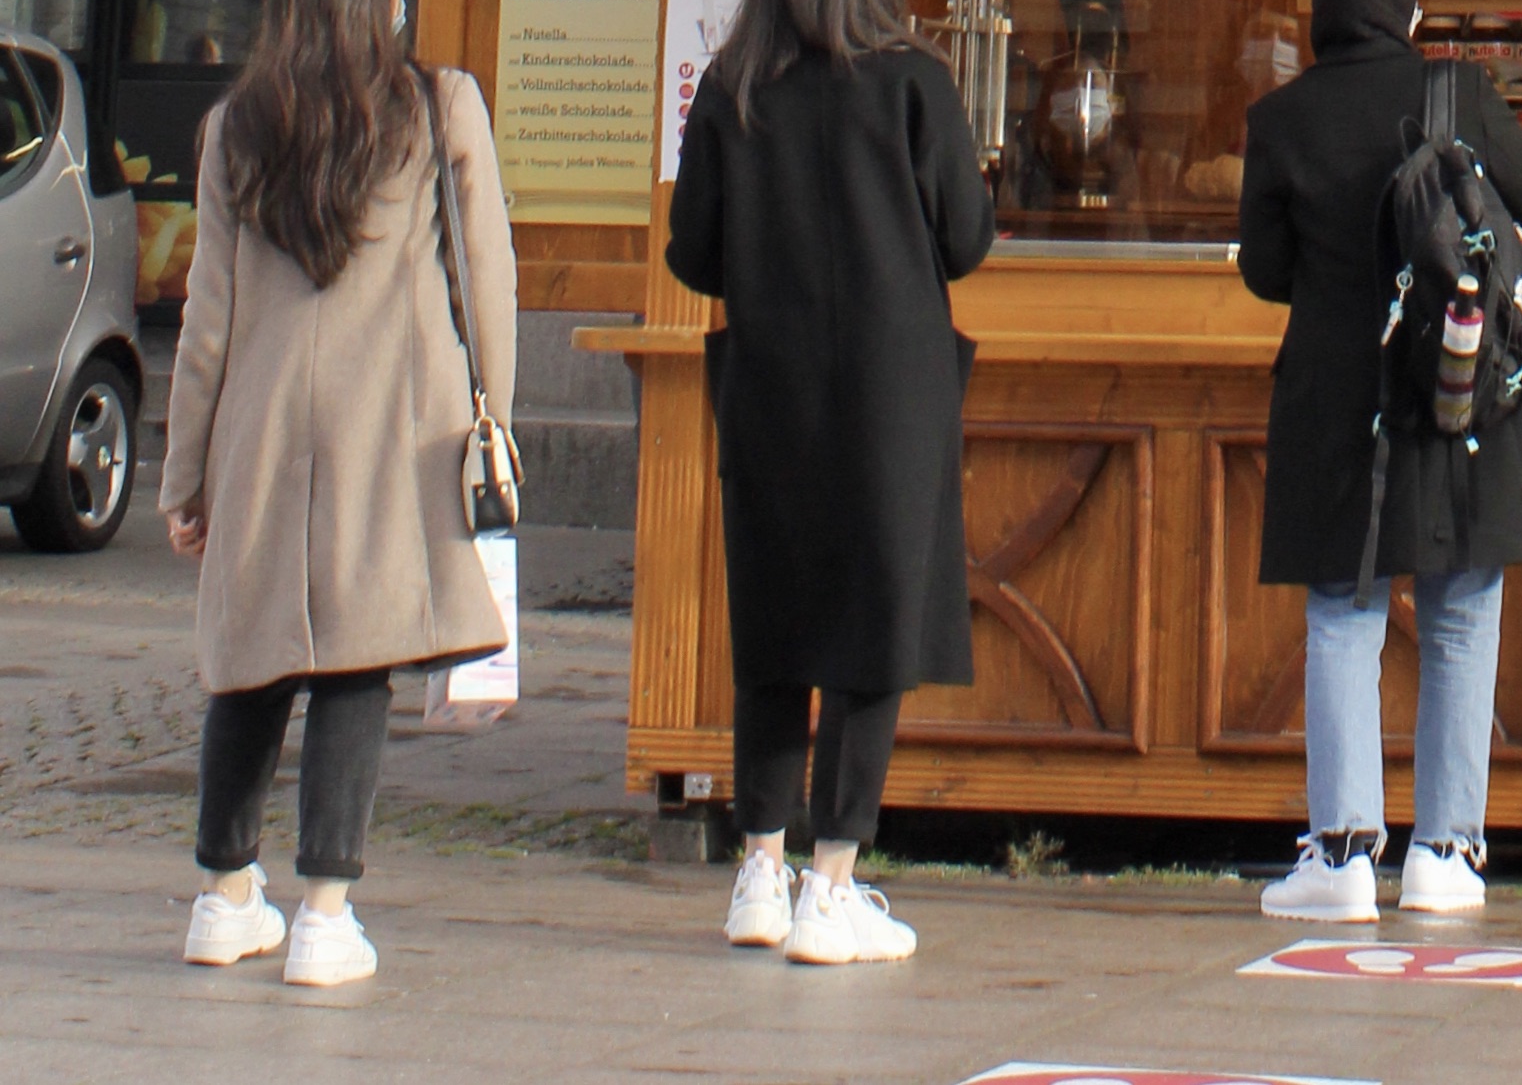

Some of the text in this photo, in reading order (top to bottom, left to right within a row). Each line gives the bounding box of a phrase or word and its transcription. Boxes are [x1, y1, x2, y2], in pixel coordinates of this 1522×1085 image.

[522, 28, 568, 41] Nutella
[521, 53, 635, 67] Kinderschokolade
[520, 78, 649, 93] Vollmilchschokolade
[561, 104, 633, 117] Schokolade
[518, 129, 648, 143] Zartbitterschokolade
